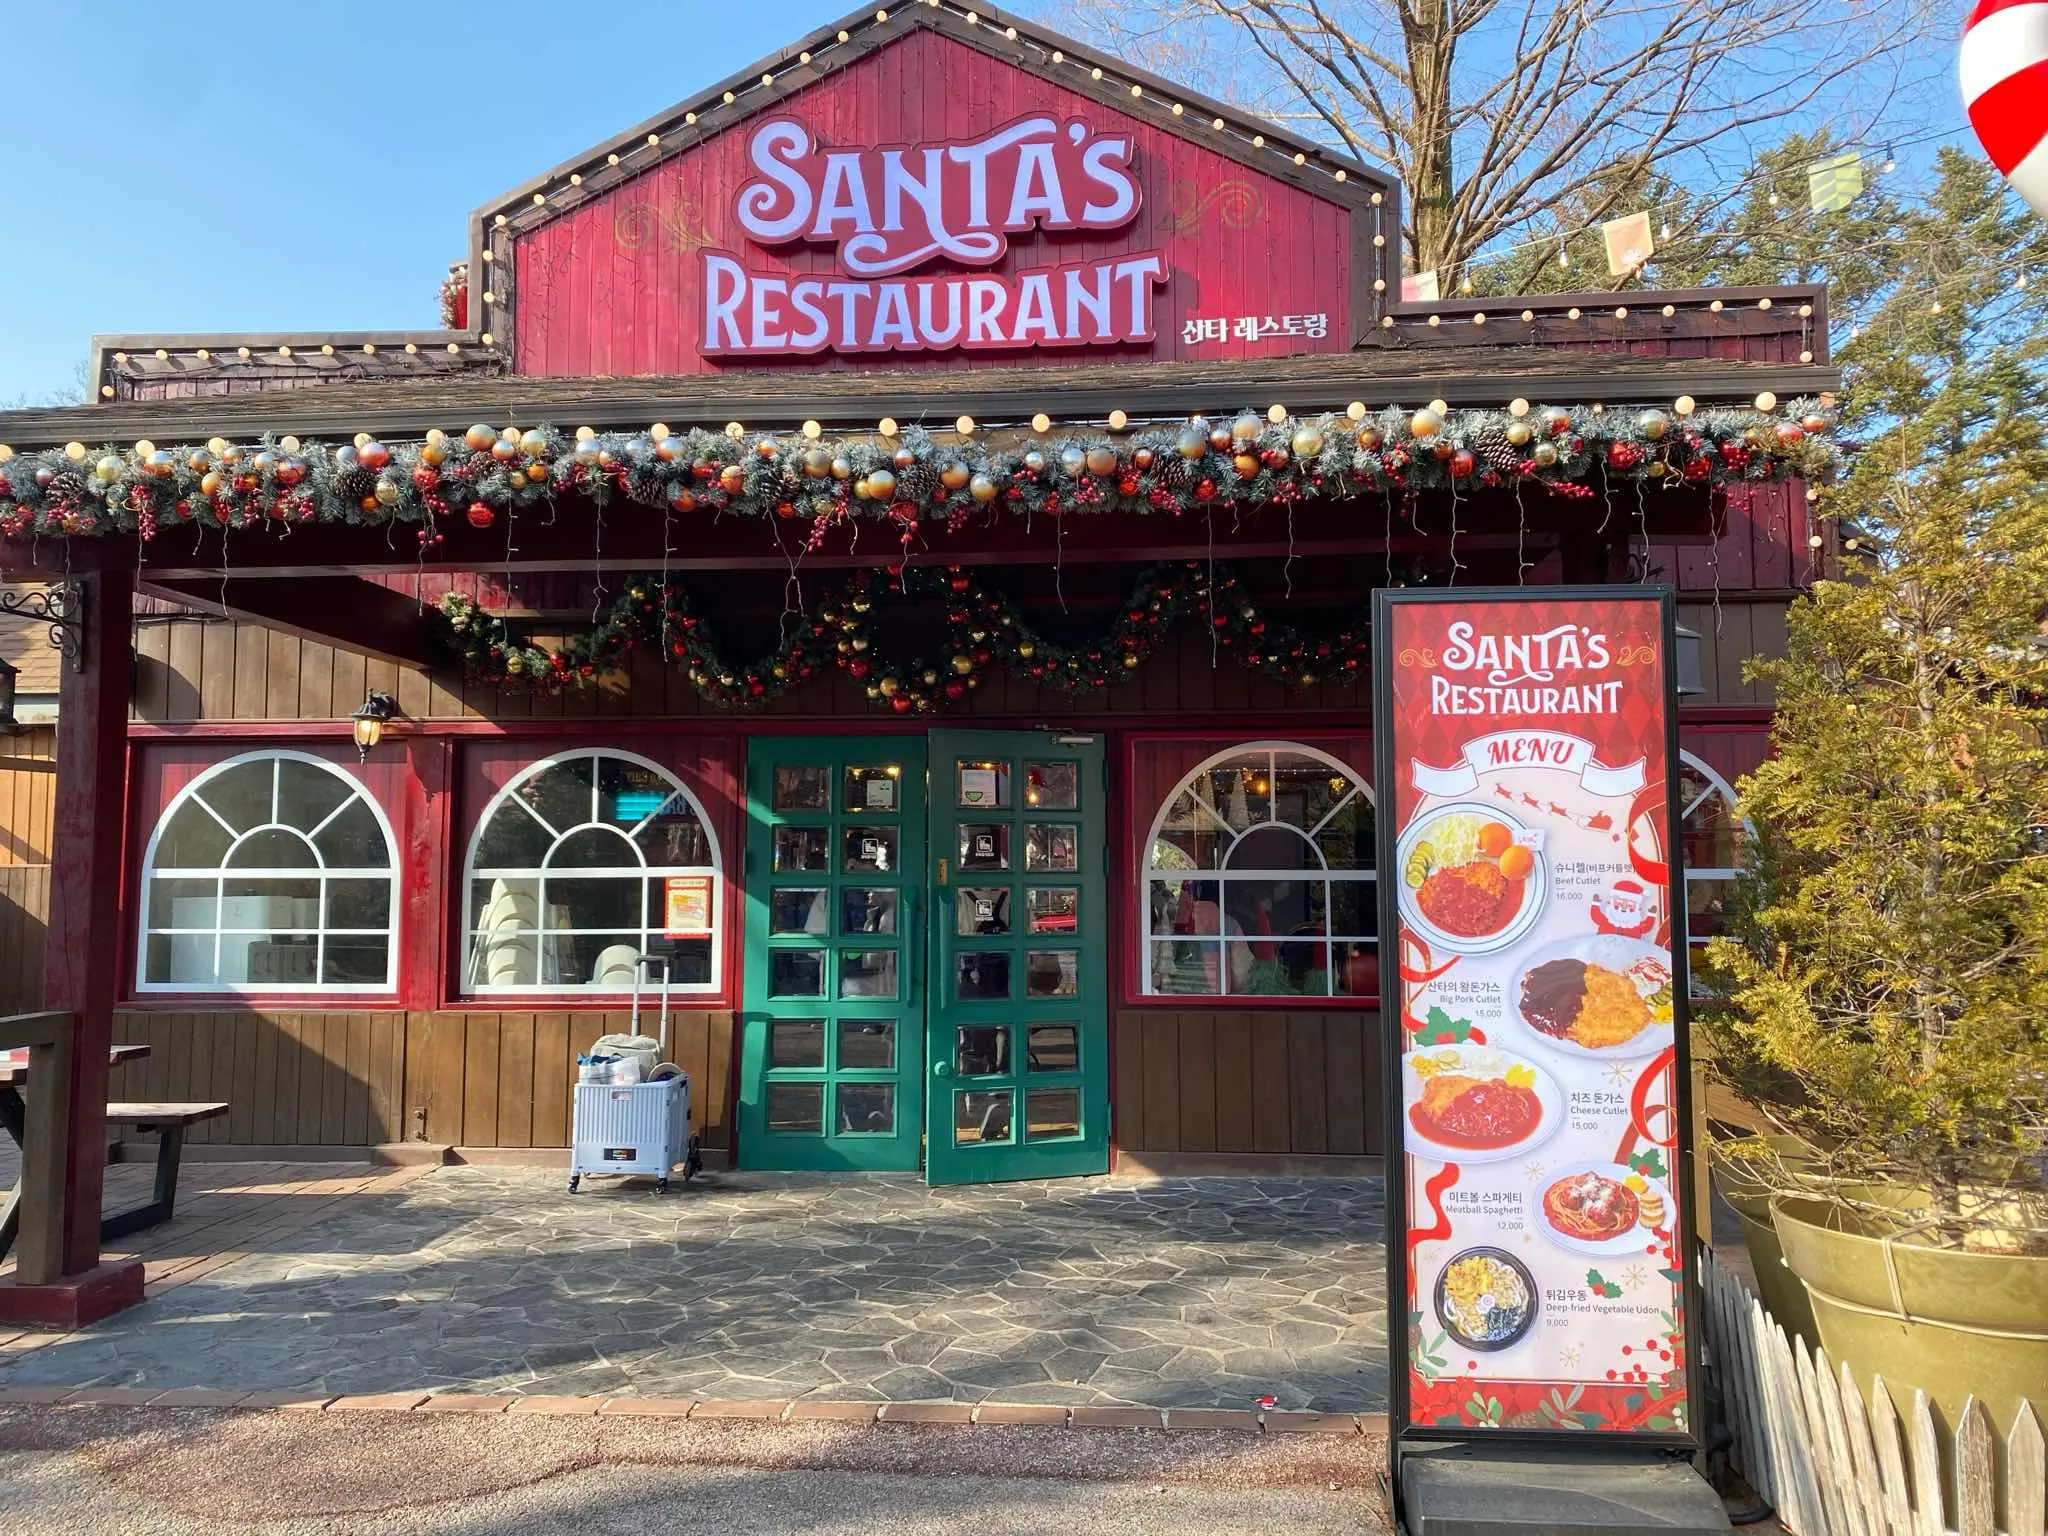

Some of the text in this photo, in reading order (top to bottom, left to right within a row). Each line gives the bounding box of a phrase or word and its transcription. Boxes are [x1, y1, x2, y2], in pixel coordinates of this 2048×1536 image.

[738, 119, 1135, 273] SANTA'S
[704, 255, 1165, 351] RESTAURANT
[1181, 313, 1328, 344] 산타 레스토랑
[1442, 621, 1610, 686] SANTA'S
[1431, 675, 1623, 715] RESTAURANT
[1487, 738, 1575, 766] MENU
[1555, 877, 1601, 885] Beef Cutlet
[1428, 981, 1501, 992] 산타의 왕돈가스
[1440, 995, 1501, 1004] Big Pork Cutlet
[1476, 1009, 1502, 1018] 15,000
[1571, 1092, 1625, 1104] 치즈 돈가스
[1571, 1105, 1628, 1115] Cheese Cutlet
[1572, 1121, 1598, 1130] 15,000
[1449, 1191, 1522, 1204] 미트볼 스파게티
[1446, 1205, 1523, 1216] Meatball Spaghetti
[1497, 1221, 1524, 1230] 12,000
[1545, 1289, 1588, 1301] 튀김우동
[1546, 1304, 1660, 1314] Deep-fried Vegetable Udon
[1546, 1319, 1568, 1327] 9,000
